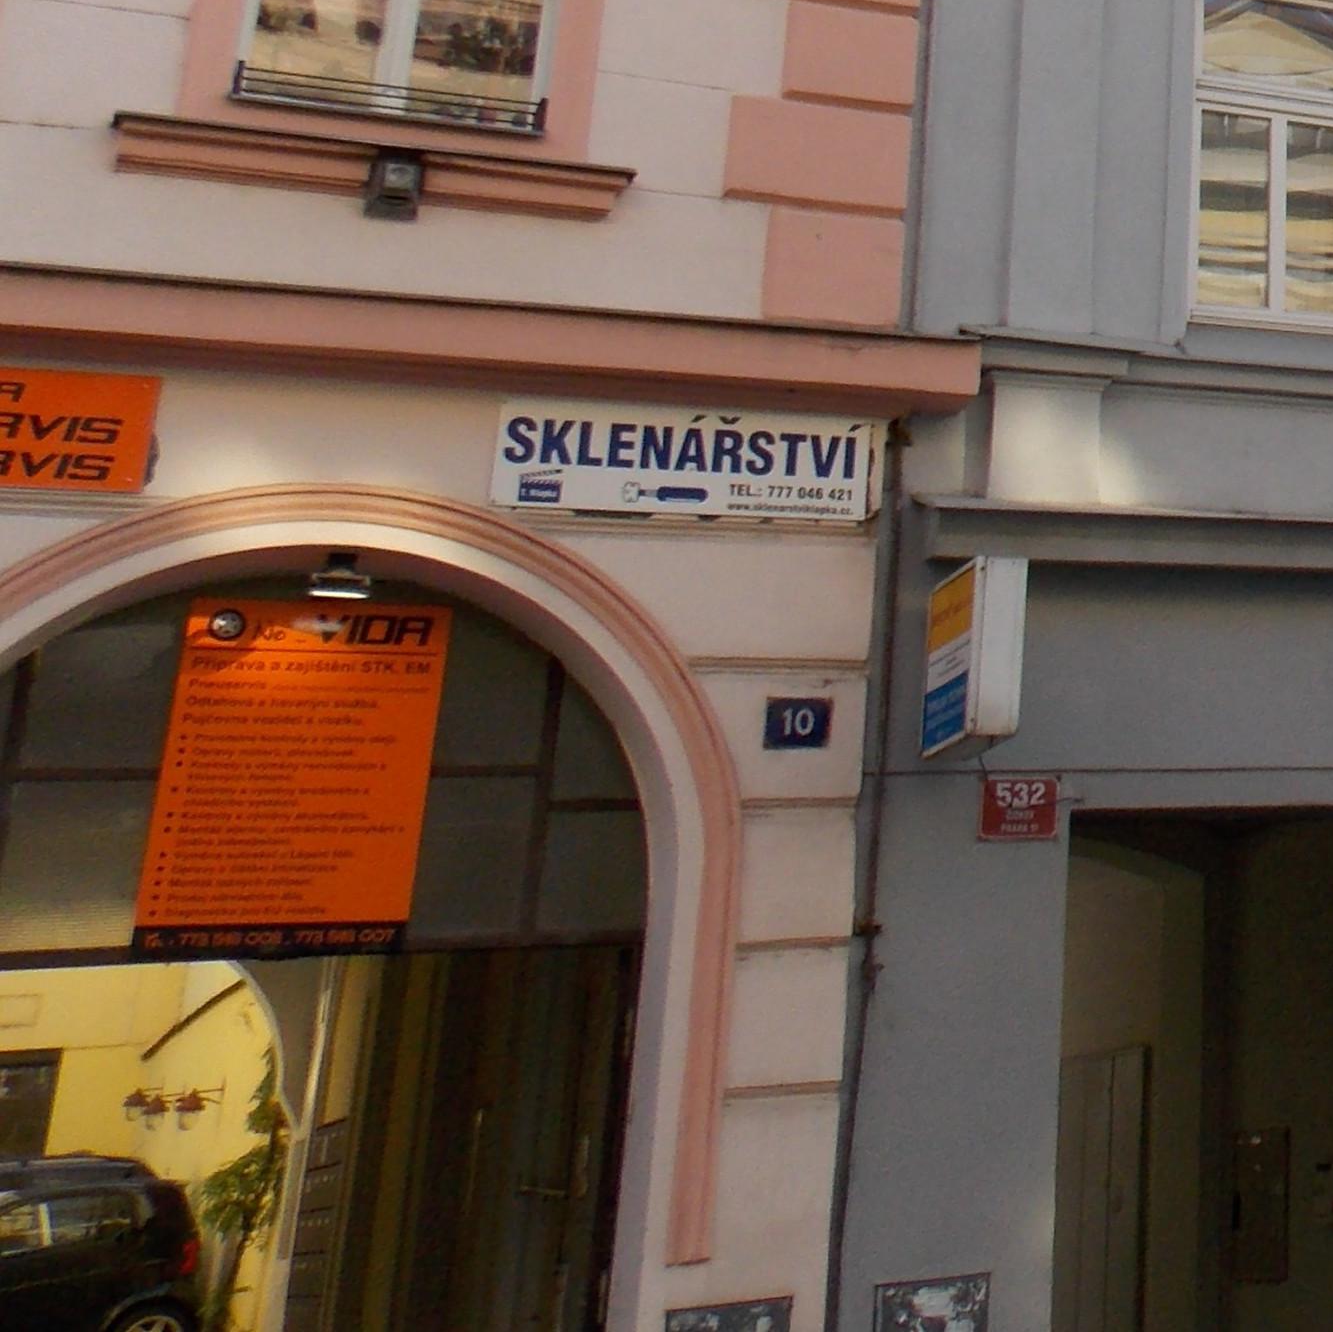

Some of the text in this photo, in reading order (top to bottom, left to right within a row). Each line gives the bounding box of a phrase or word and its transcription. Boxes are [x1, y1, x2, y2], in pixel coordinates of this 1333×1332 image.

[504, 414, 867, 479] SKLENÁŘSTVÍ
[768, 485, 793, 498] 777
[797, 487, 823, 500] 046
[828, 488, 852, 500] 421
[782, 708, 815, 736] 10
[996, 782, 1047, 809] 532
